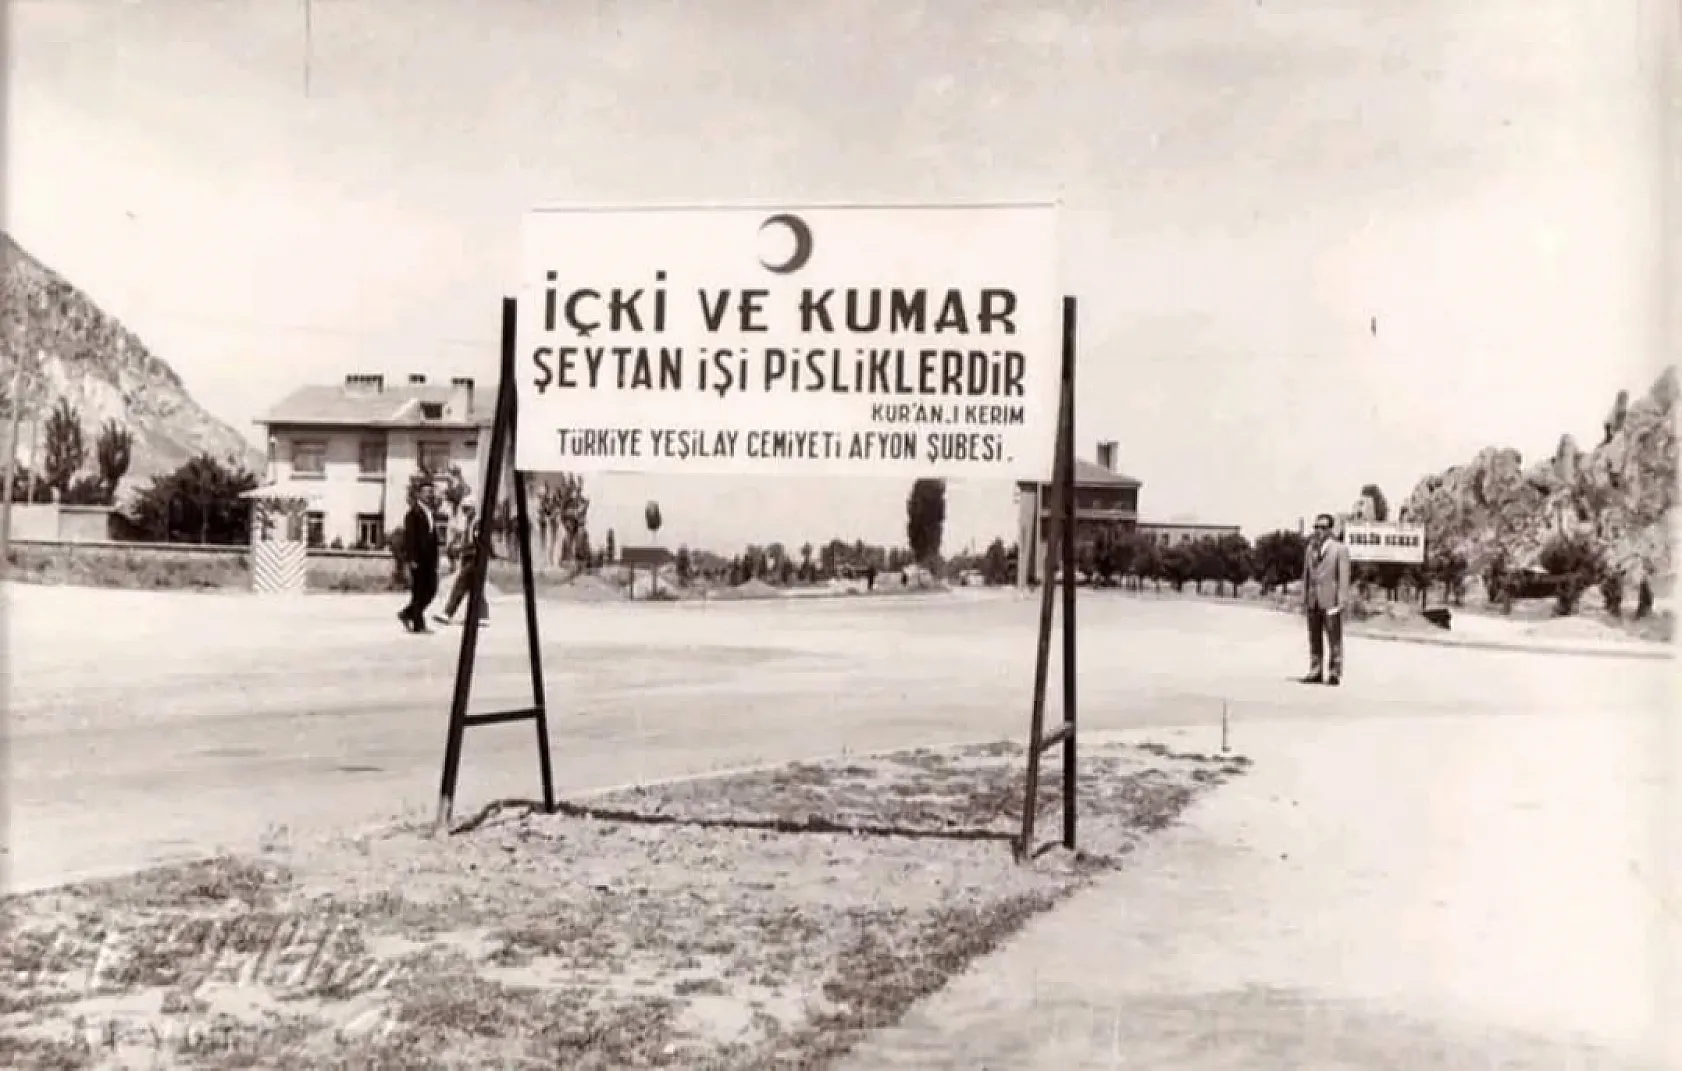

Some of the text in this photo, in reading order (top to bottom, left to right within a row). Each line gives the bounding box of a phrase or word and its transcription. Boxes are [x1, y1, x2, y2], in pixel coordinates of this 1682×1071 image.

[545, 271, 1017, 337] İÇKİ VE KUMAR
[533, 347, 683, 395] ŞEYTAN
[764, 348, 1026, 397] PİSLİKLERDİR
[558, 428, 641, 456] TÜRKİYE
[651, 430, 738, 459] YEŞİLAY
[848, 432, 916, 459] AFYON
